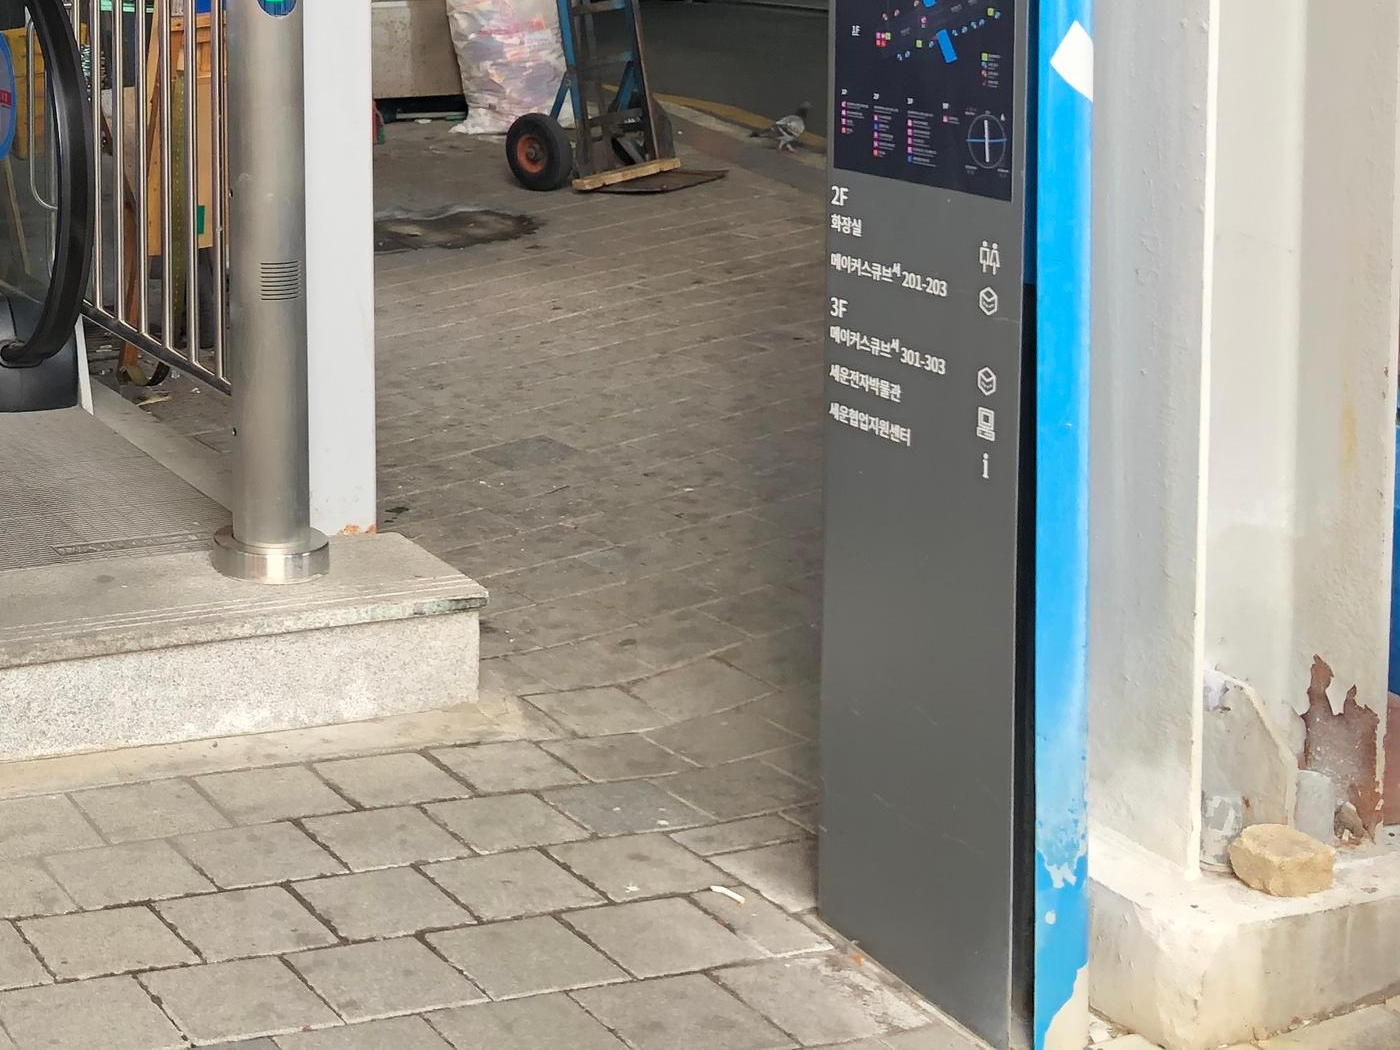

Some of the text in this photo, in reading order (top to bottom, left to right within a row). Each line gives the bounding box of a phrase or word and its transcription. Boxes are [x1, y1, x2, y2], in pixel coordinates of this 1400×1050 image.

[831, 185, 849, 206] 2F
[830, 214, 862, 237] 화장실
[901, 271, 948, 297] 201-203
[830, 297, 848, 318] 3F
[900, 347, 946, 375] 301-303
[829, 364, 902, 403] 세운전자박물관
[829, 402, 911, 447] 세운협업지원센터
